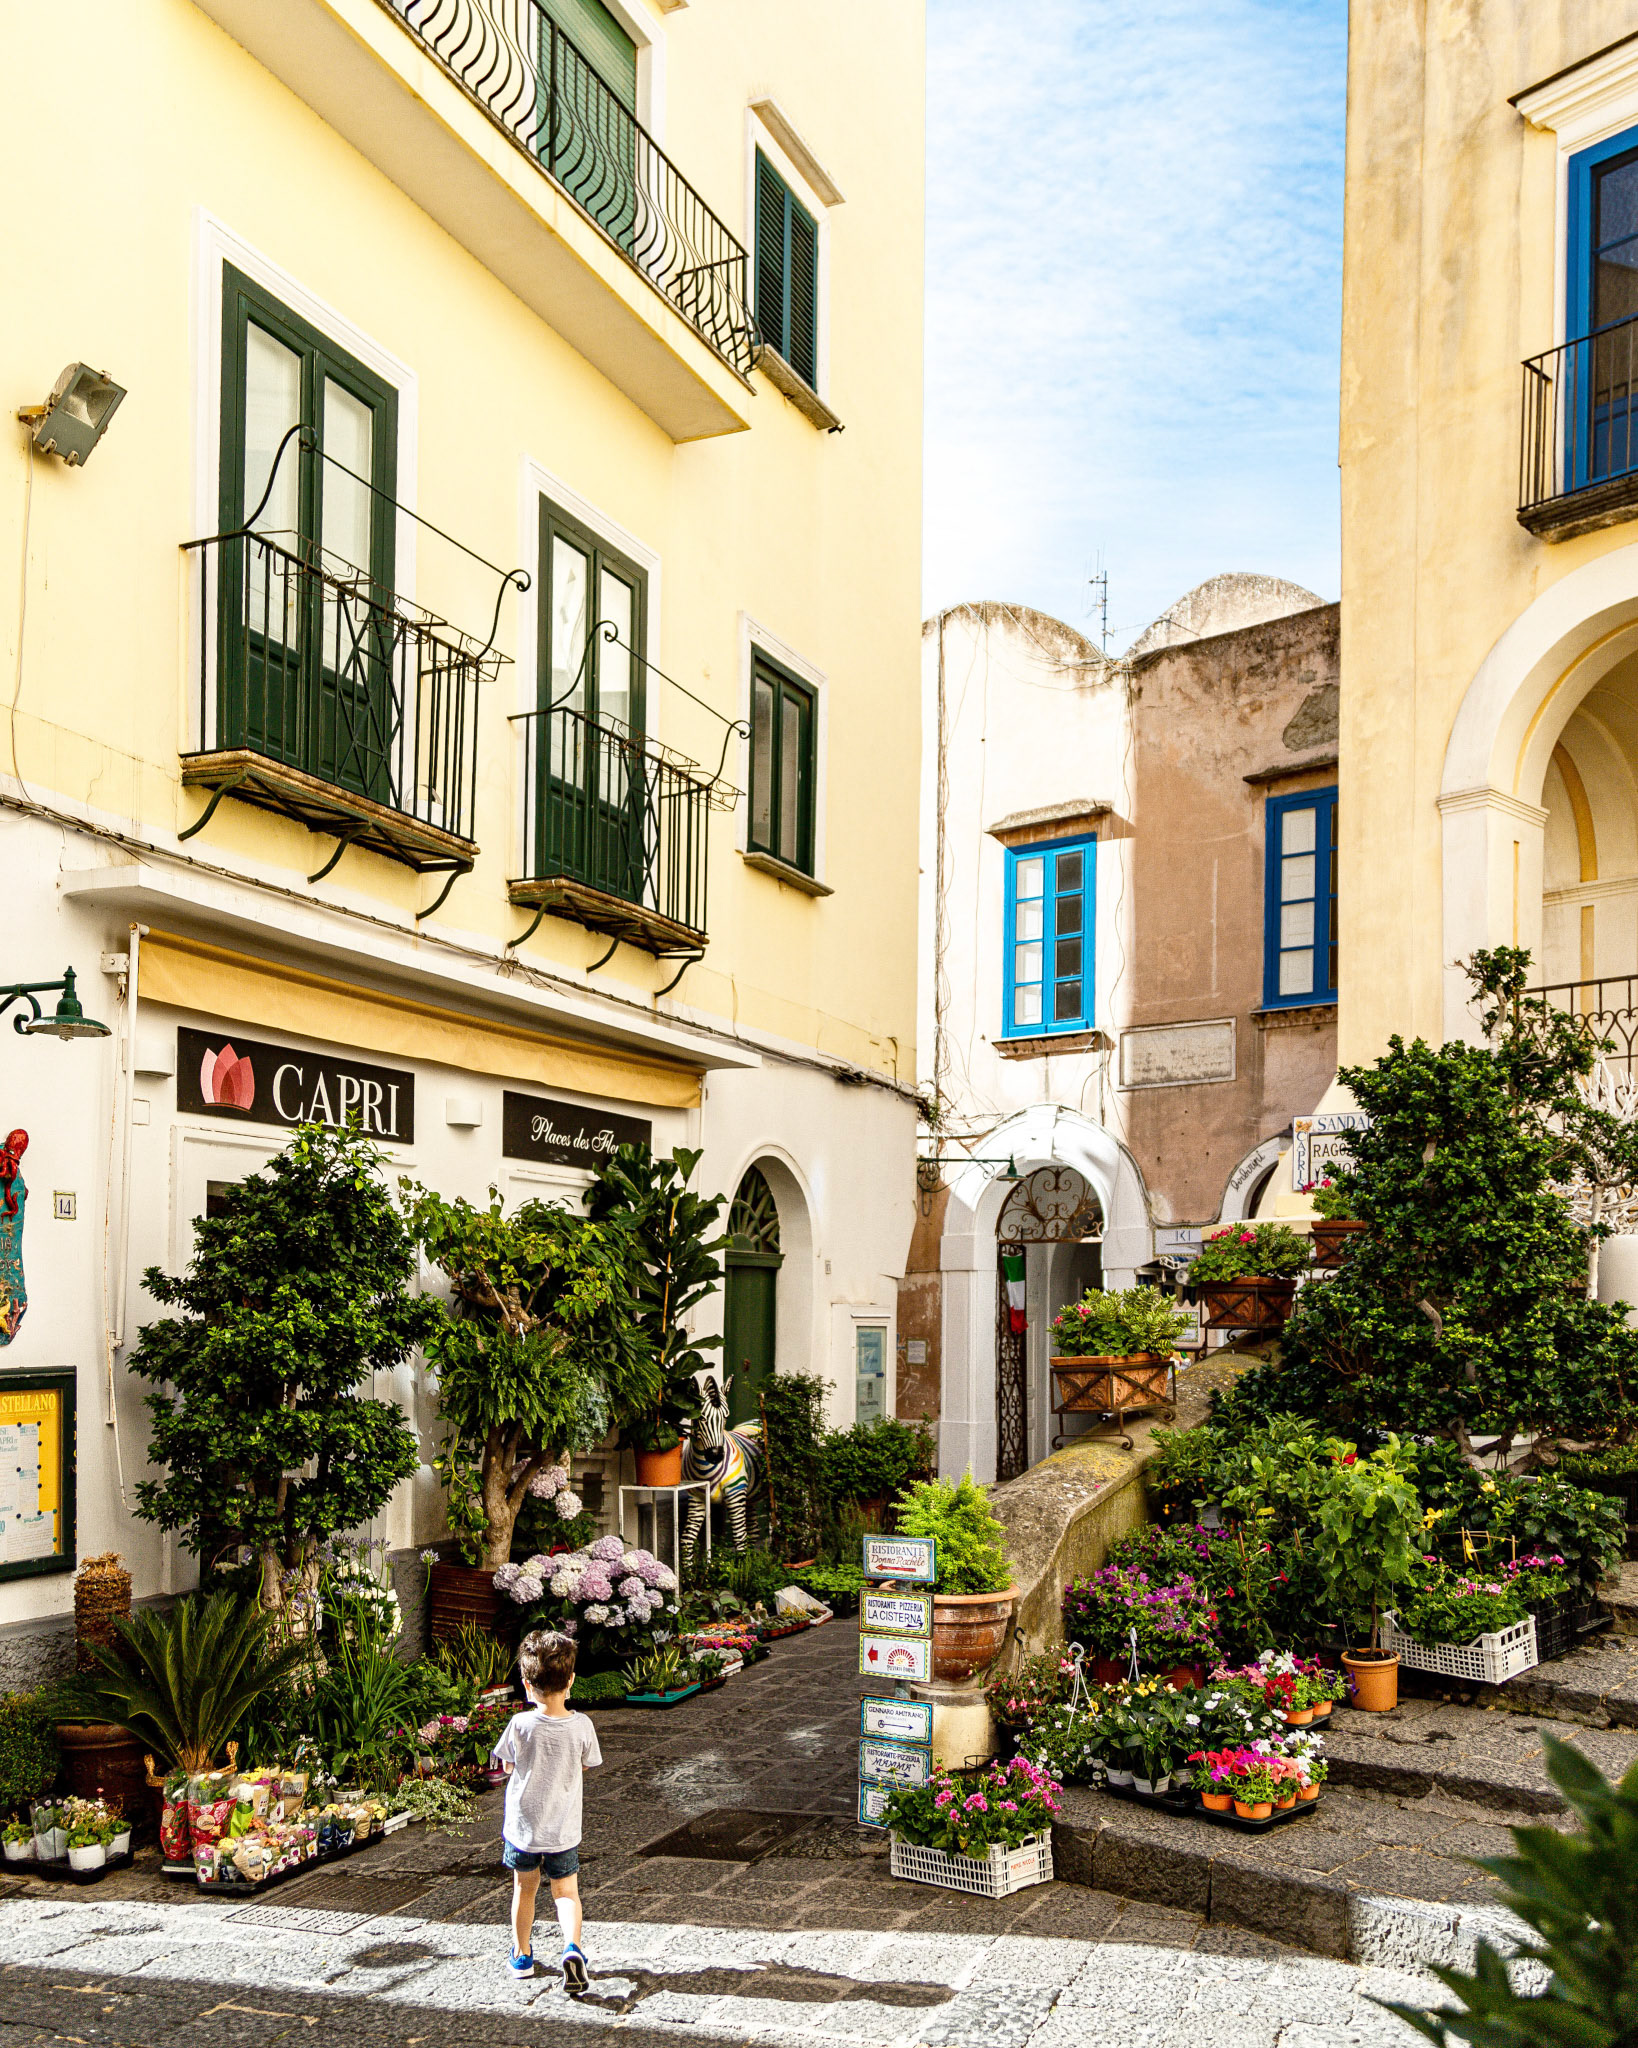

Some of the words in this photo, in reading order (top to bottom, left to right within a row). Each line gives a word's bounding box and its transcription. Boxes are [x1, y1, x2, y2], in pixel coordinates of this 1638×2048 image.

[272, 1064, 400, 1137] CAPRI
[531, 1114, 571, 1147] Places
[573, 1127, 590, 1150] des
[59, 1198, 71, 1216] 14
[871, 1545, 925, 1557] RISTORANTE
[871, 1554, 896, 1565] Donna
[867, 1599, 897, 1610] RISTORANTE
[899, 1602, 924, 1613] PIZZERIA
[867, 1610, 879, 1620] LA
[879, 1610, 922, 1624] CISTERNA
[868, 1706, 894, 1716] GENNARO
[895, 1709, 924, 1719] AMITRANO
